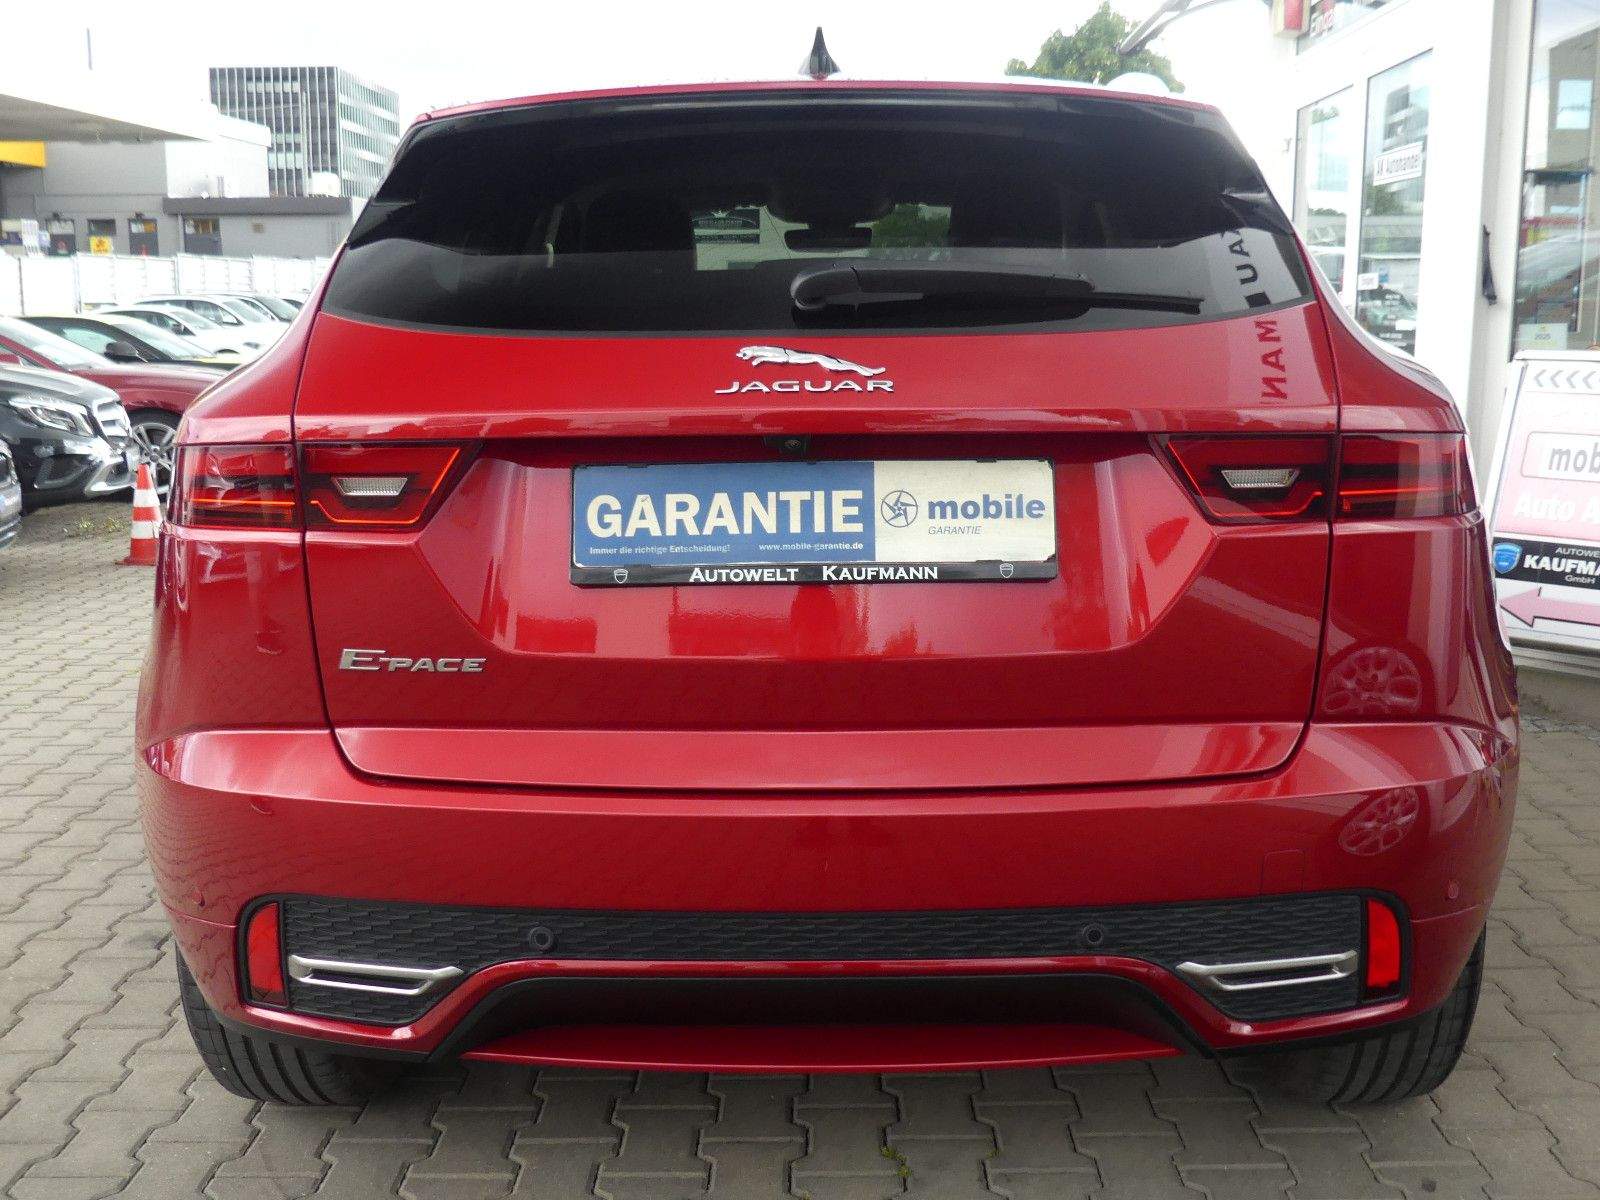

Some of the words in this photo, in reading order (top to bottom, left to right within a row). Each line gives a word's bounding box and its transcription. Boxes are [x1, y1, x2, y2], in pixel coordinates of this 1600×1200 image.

[714, 380, 894, 394] JAGUAR
[586, 489, 864, 538] GARANTIE
[927, 493, 1046, 520] mobile
[927, 525, 982, 535] GARANTIE
[589, 546, 617, 555] Immer
[619, 546, 633, 554] die
[635, 545, 667, 555] richtige
[669, 544, 731, 555] Entscheidung!
[758, 541, 864, 552] www.mobile-garantie.de
[1523, 554, 1600, 577] KAUFM
[689, 567, 799, 582] AUTOWELT
[822, 565, 938, 581] KAUFMANN
[1565, 574, 1596, 584] GmbH
[339, 648, 487, 672] E-PACE
